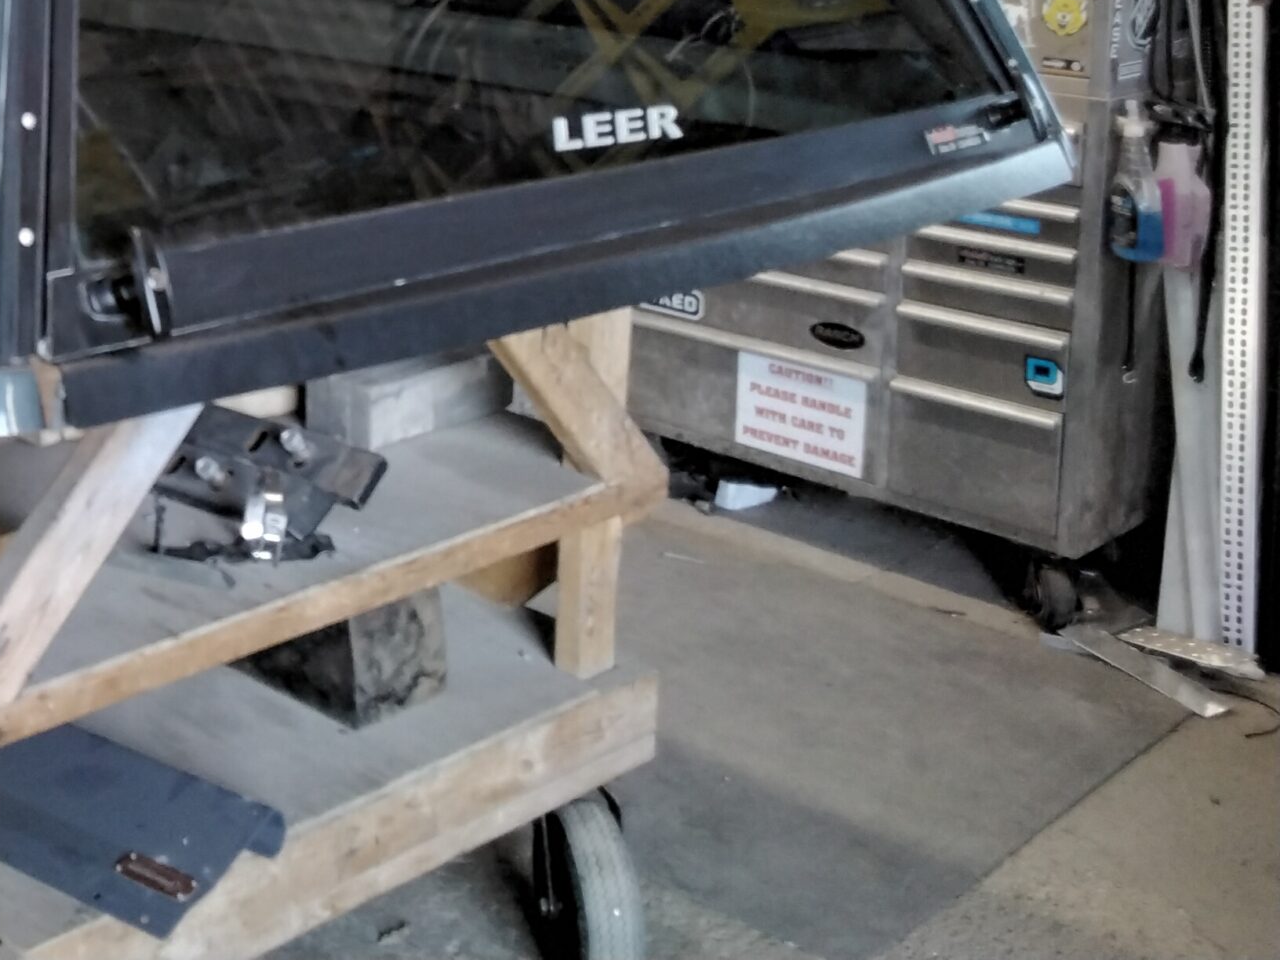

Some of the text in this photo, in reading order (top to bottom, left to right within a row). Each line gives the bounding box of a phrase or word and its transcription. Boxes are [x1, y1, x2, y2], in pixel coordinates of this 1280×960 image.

[552, 103, 684, 152] LEER
[749, 381, 852, 419] PLEASE HANDLE
[754, 405, 845, 441] WITH CARE TO
[742, 425, 856, 468] PREVENT DAMAGE
